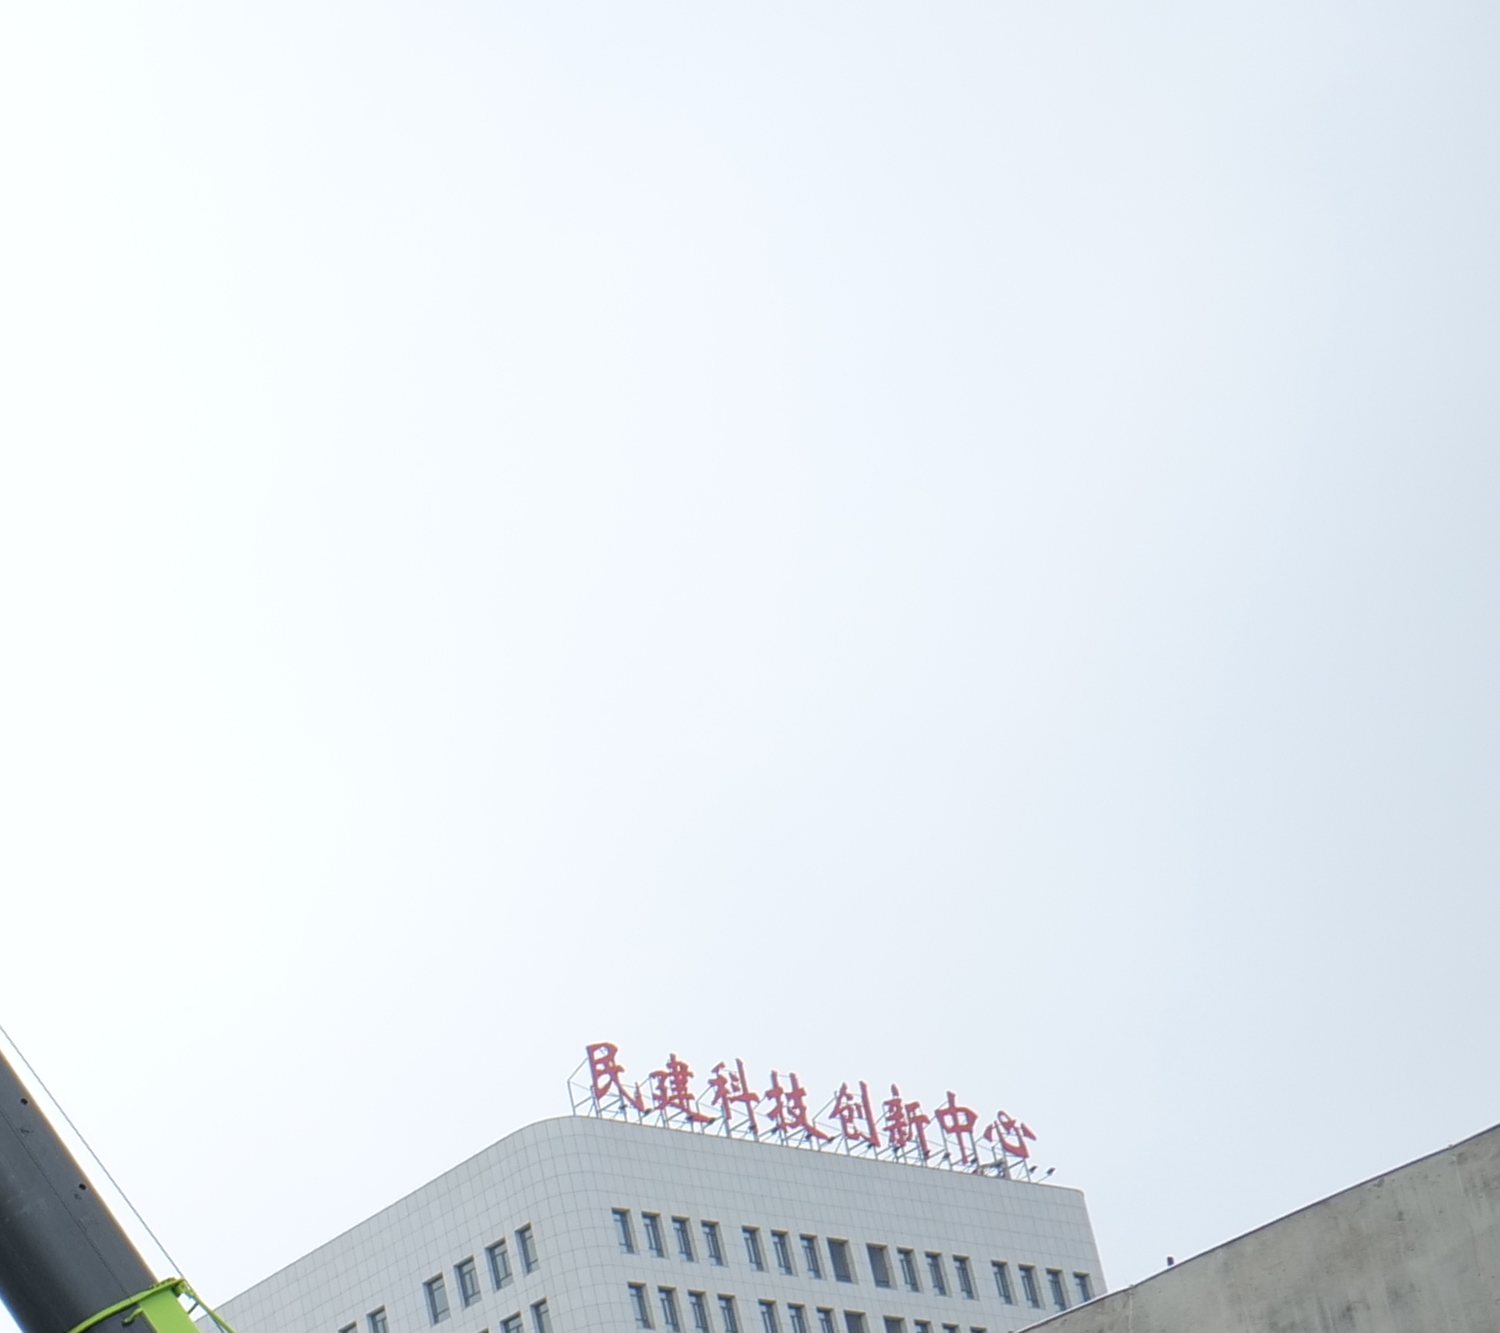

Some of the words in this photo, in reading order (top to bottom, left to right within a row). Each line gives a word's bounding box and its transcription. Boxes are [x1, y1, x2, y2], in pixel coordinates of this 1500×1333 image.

[586, 1042, 1036, 1165] 民建科技创新中心
